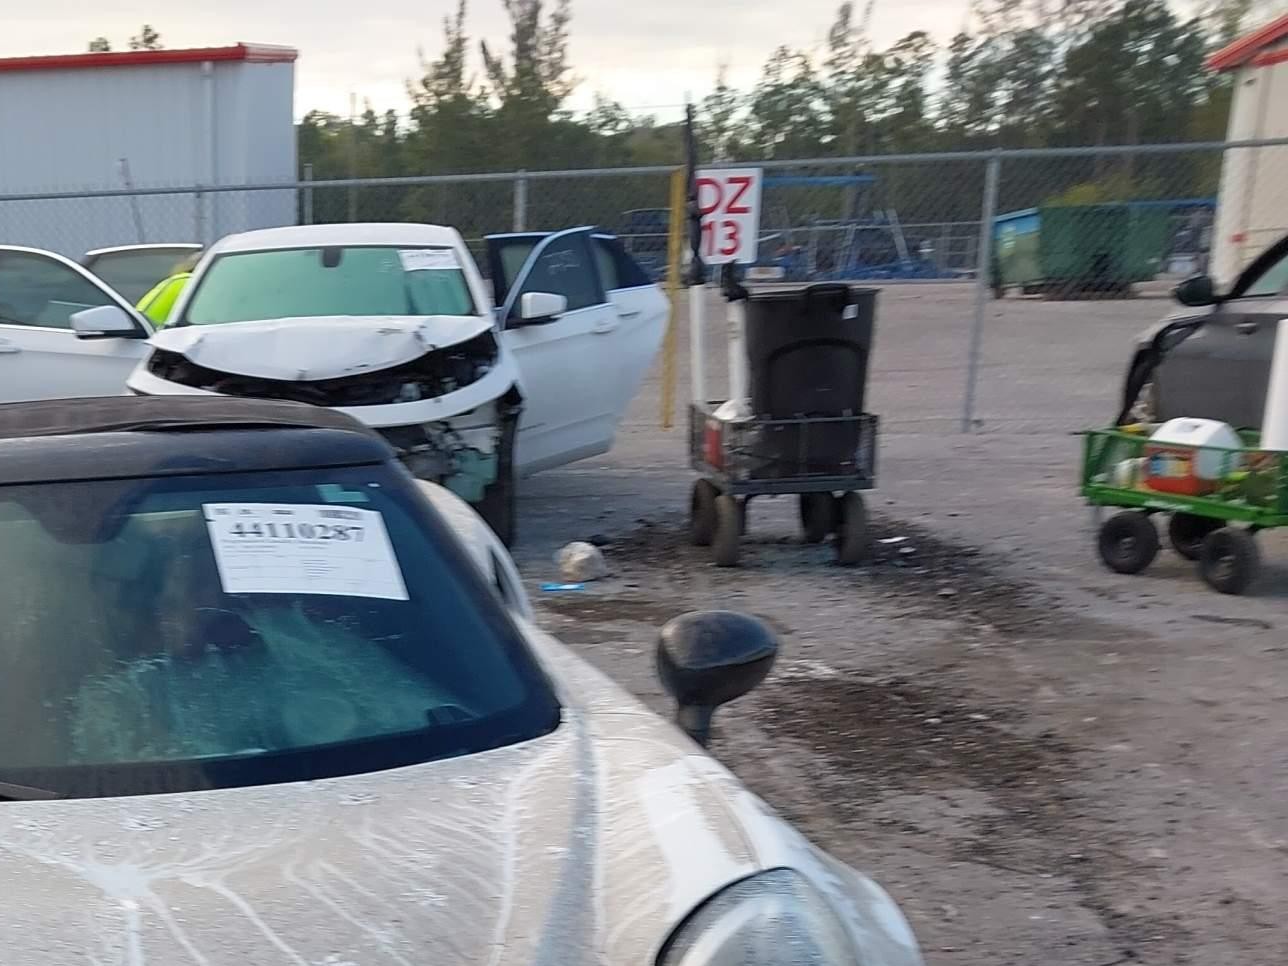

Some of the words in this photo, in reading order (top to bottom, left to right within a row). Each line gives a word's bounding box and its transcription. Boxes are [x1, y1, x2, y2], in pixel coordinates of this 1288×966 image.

[695, 176, 753, 213] DZ
[700, 220, 740, 255] 13
[230, 522, 365, 541] 44110287
